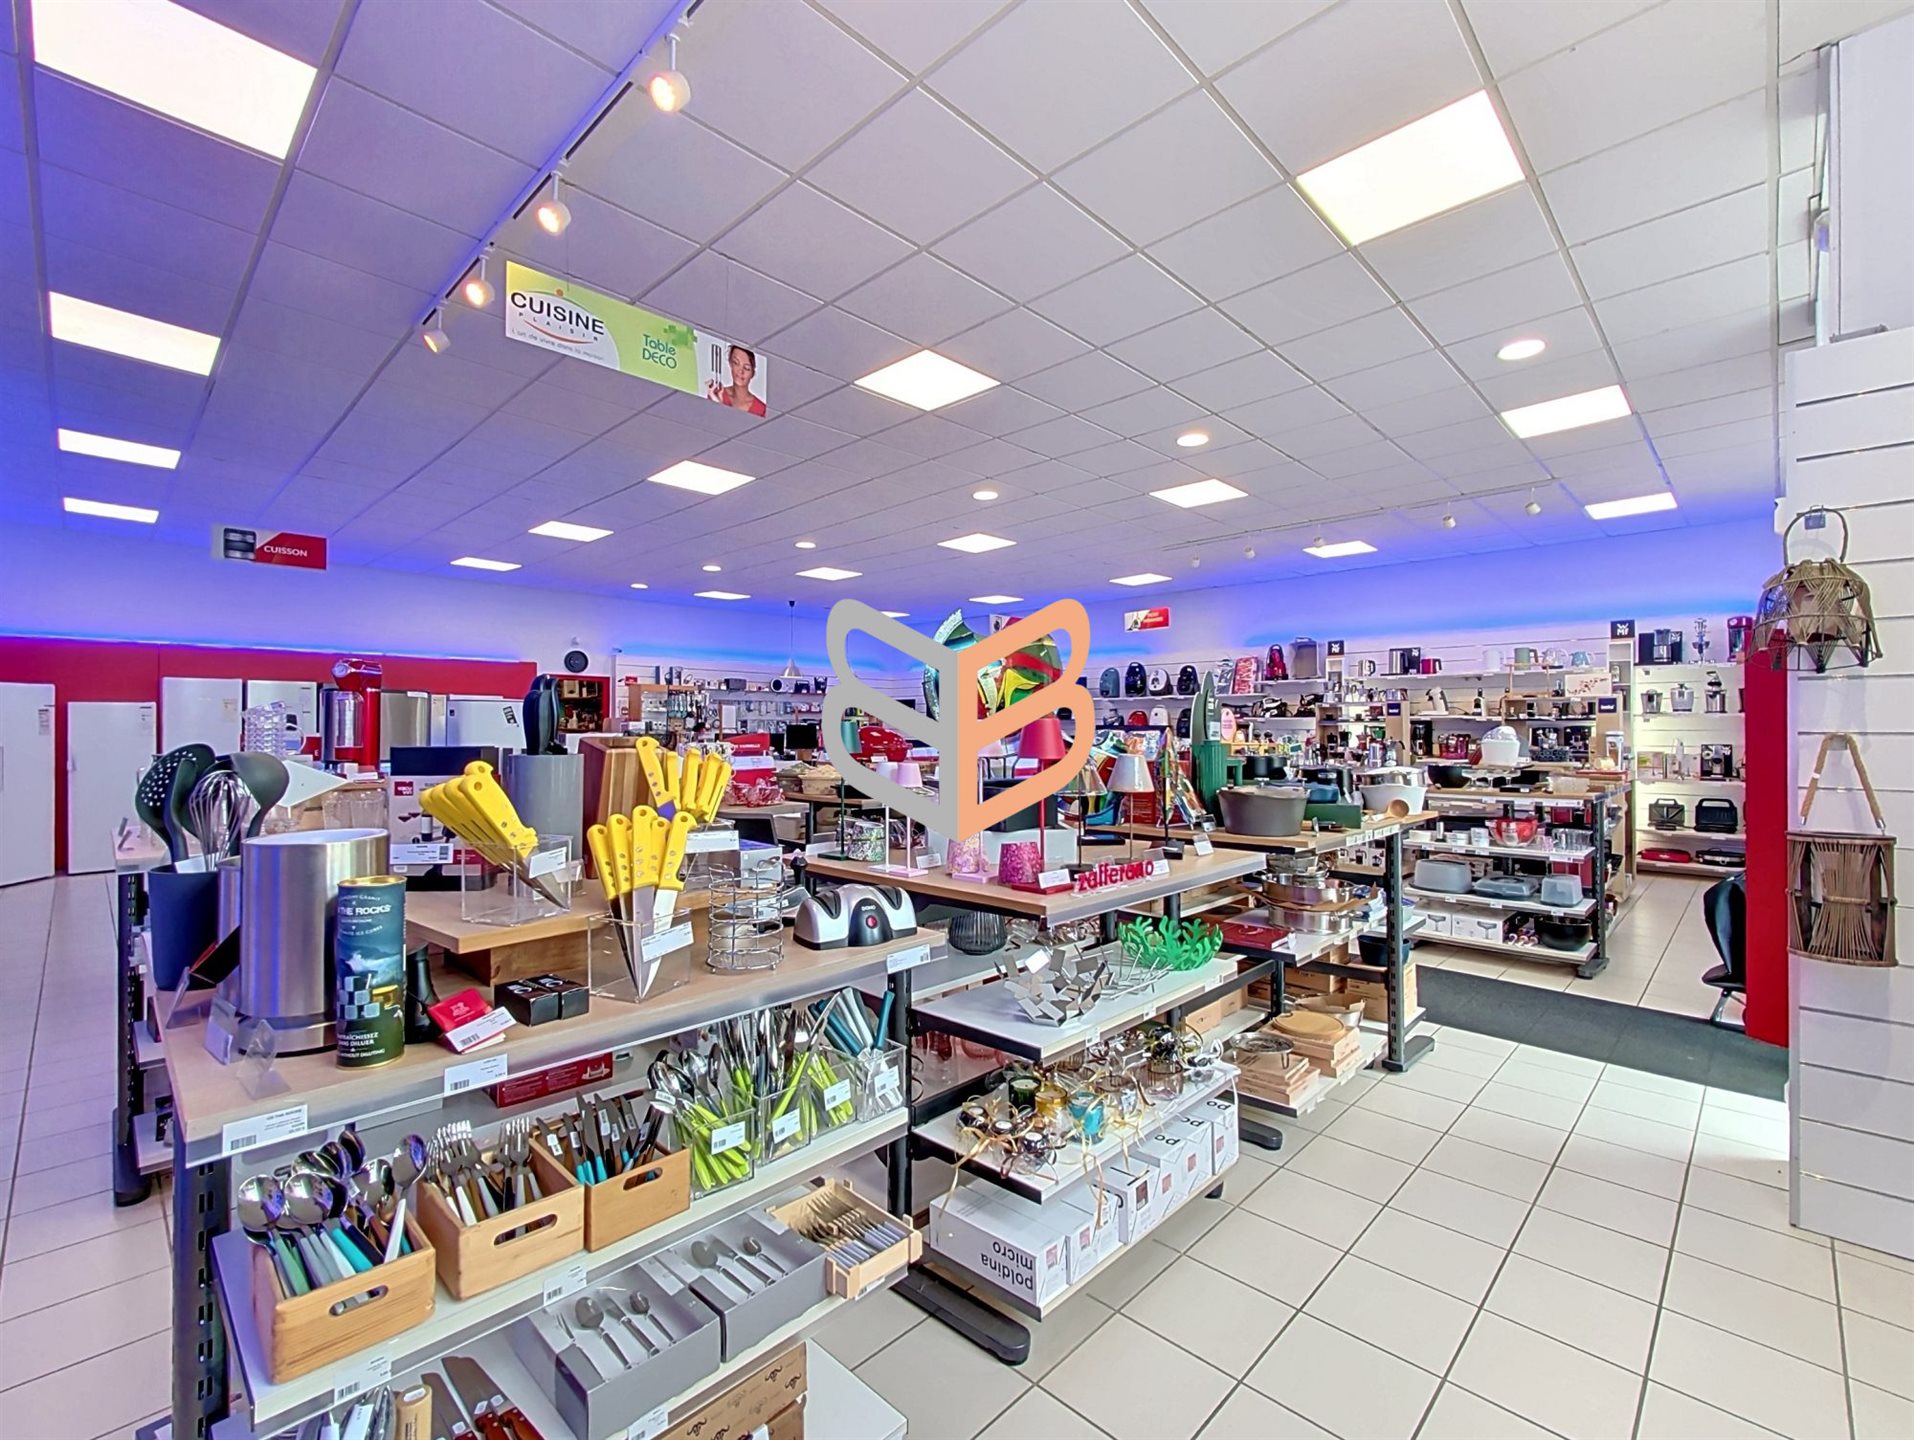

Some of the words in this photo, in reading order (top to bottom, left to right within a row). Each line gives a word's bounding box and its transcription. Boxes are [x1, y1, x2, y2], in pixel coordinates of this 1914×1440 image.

[510, 292, 605, 335] CUISINE
[642, 332, 676, 356] Table
[263, 544, 308, 557] CUISSON
[355, 904, 392, 916] ROCKS
[992, 1241, 1033, 1271] micro
[980, 1252, 1034, 1291] poldina
